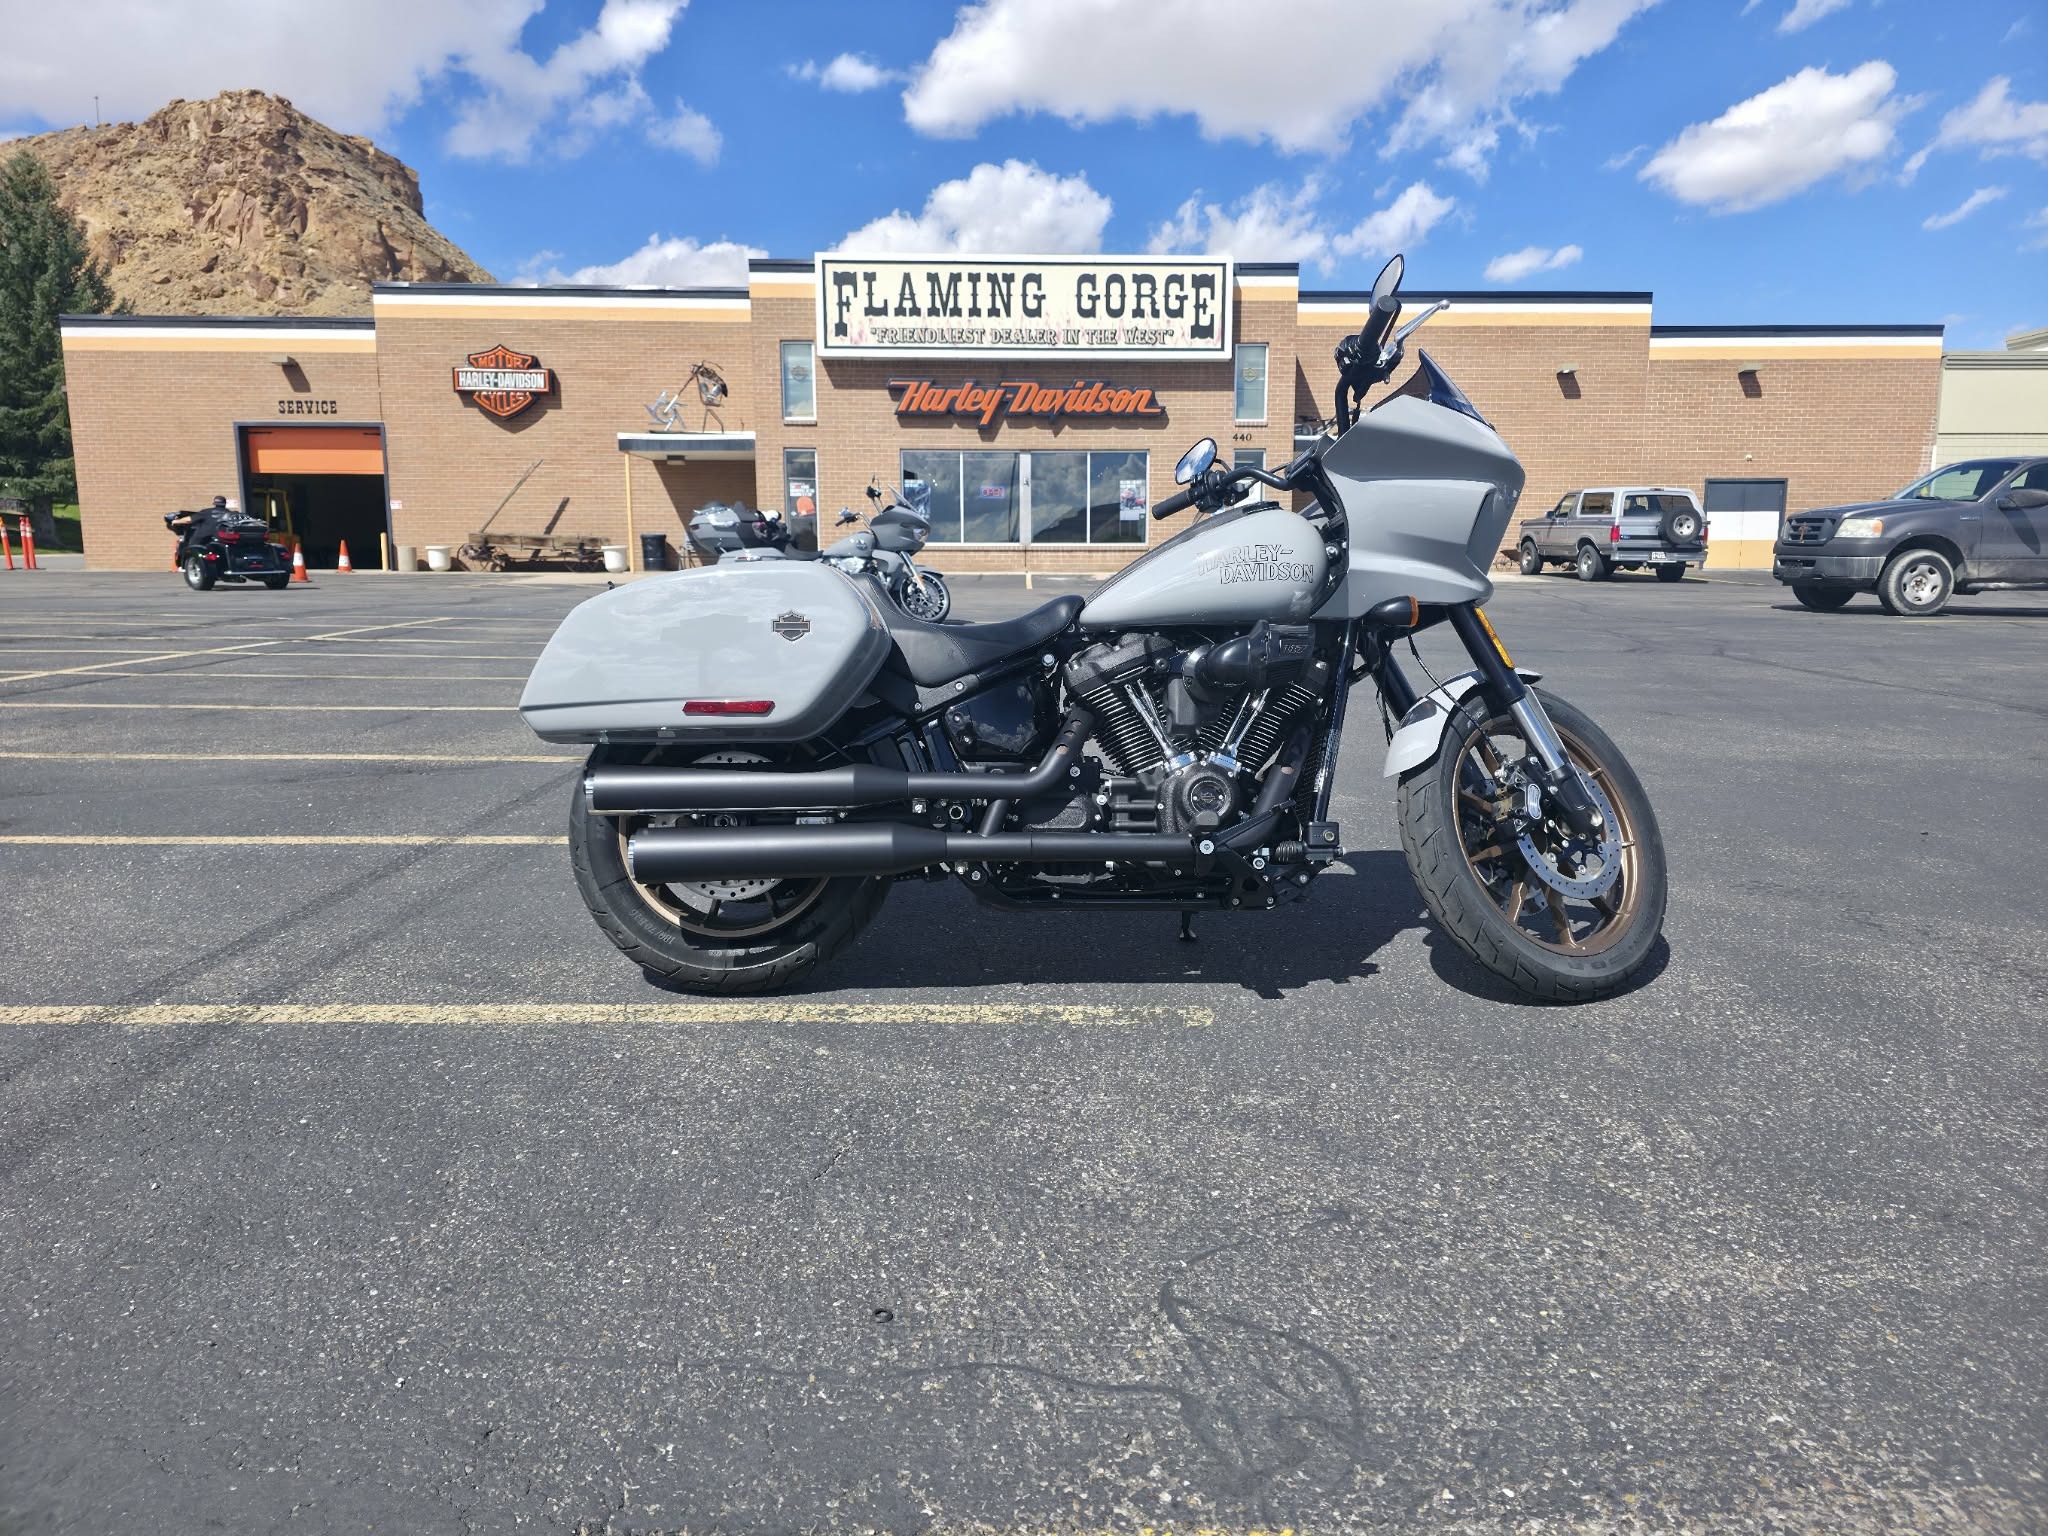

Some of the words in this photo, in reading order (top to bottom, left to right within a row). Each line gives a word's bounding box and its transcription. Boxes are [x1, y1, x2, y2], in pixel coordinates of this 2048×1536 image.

[832, 271, 1046, 337] FLAMING
[1076, 273, 1216, 339] GORGE
[870, 327, 986, 344] "FRIENDLIEST
[991, 328, 1058, 345] DEALER
[1063, 329, 1080, 345] IN
[1085, 328, 1118, 345] THE
[1123, 326, 1174, 345] WEST"
[478, 351, 525, 368] MOTOR
[458, 371, 545, 389] HARLEY-DAVIDSON
[278, 399, 337, 415] SERVICE
[480, 392, 525, 411] CYCLES
[889, 380, 1162, 425] Harley-Davidson
[1232, 432, 1252, 442] 440
[1220, 562, 1314, 584] DAVIDSON
